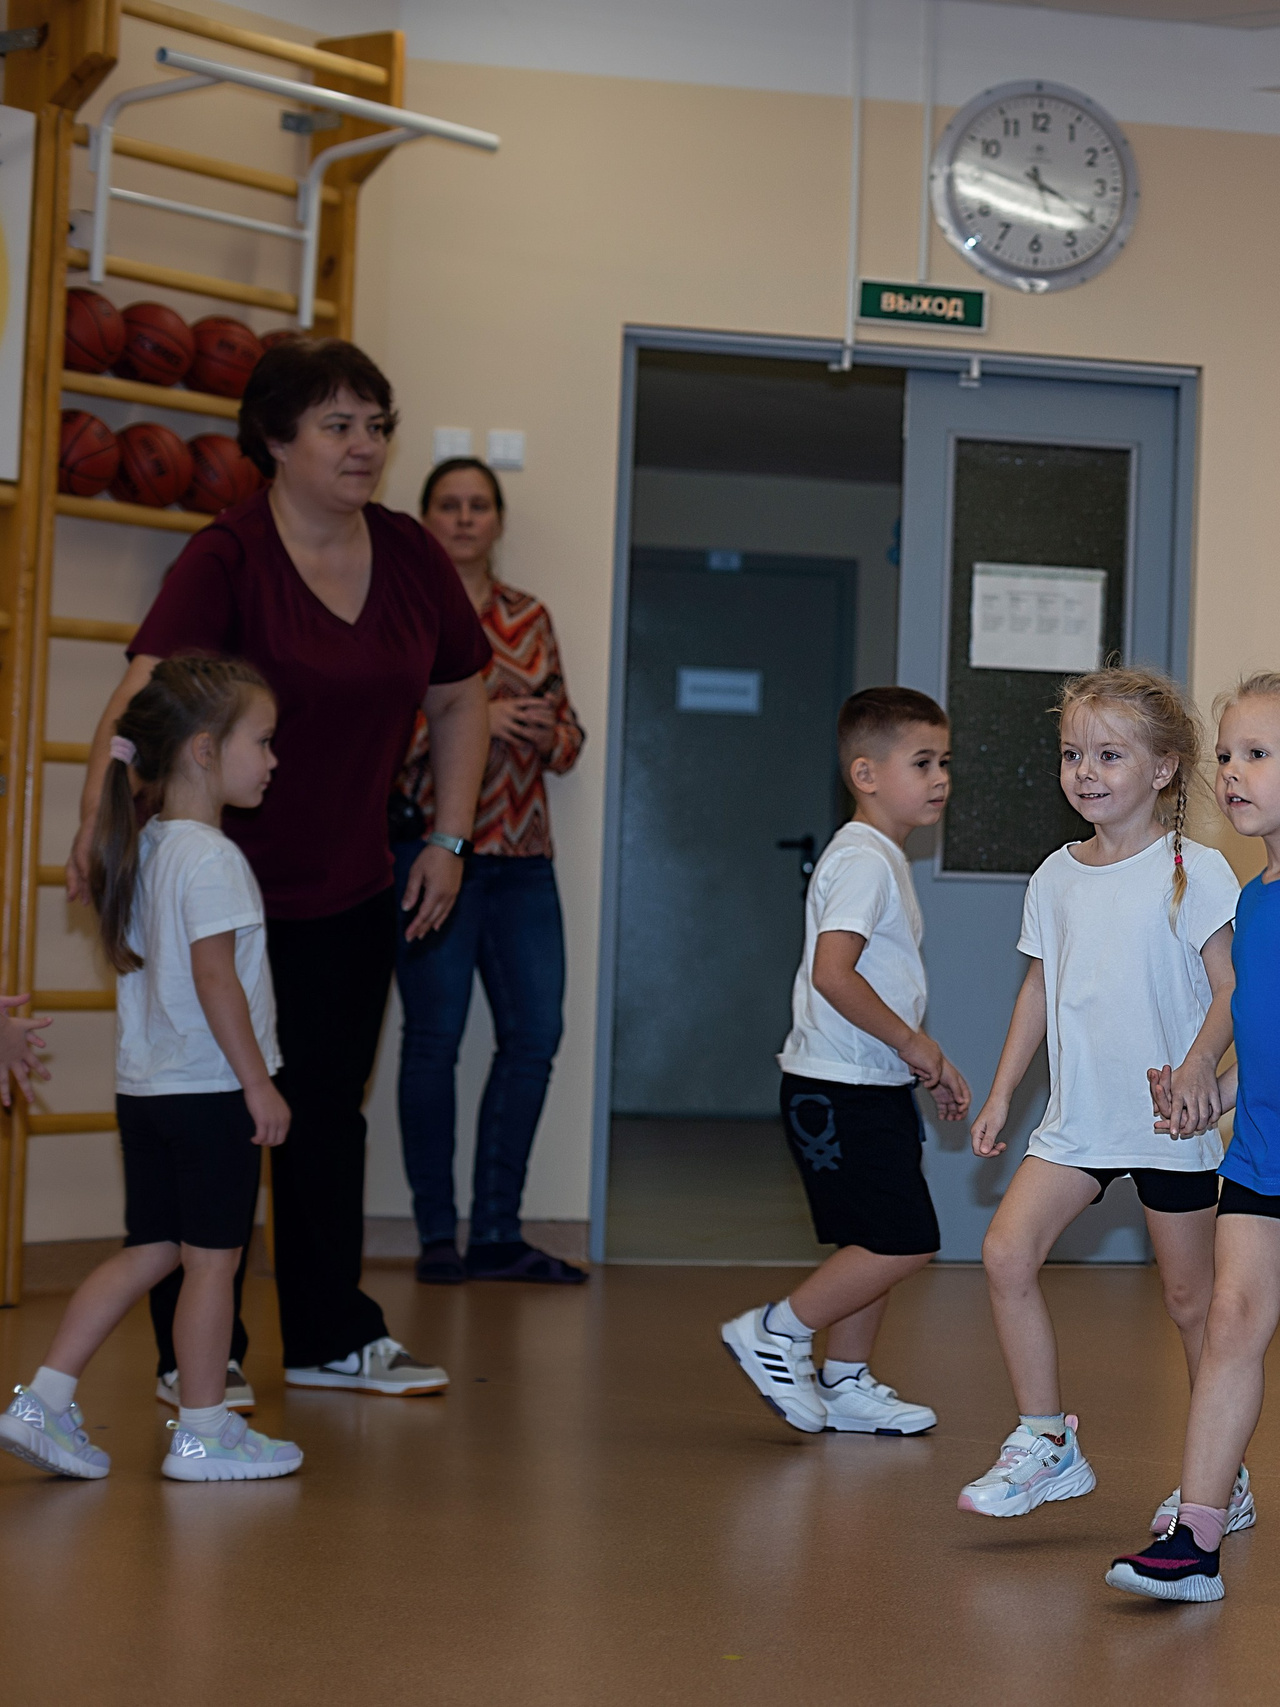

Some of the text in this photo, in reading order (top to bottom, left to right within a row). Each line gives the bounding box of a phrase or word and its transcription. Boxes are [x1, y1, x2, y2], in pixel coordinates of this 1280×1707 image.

[1003, 118, 1020, 137] 11
[1032, 112, 1051, 132] 12
[1068, 122, 1076, 142] 1
[981, 139, 1001, 159] 10
[1086, 147, 1099, 167] 2
[1094, 179, 1107, 198] 3
[998, 222, 1012, 242] 7
[1064, 229, 1077, 247] 5
[1028, 233, 1042, 253] 6
[881, 291, 965, 321] ВЫХОД
